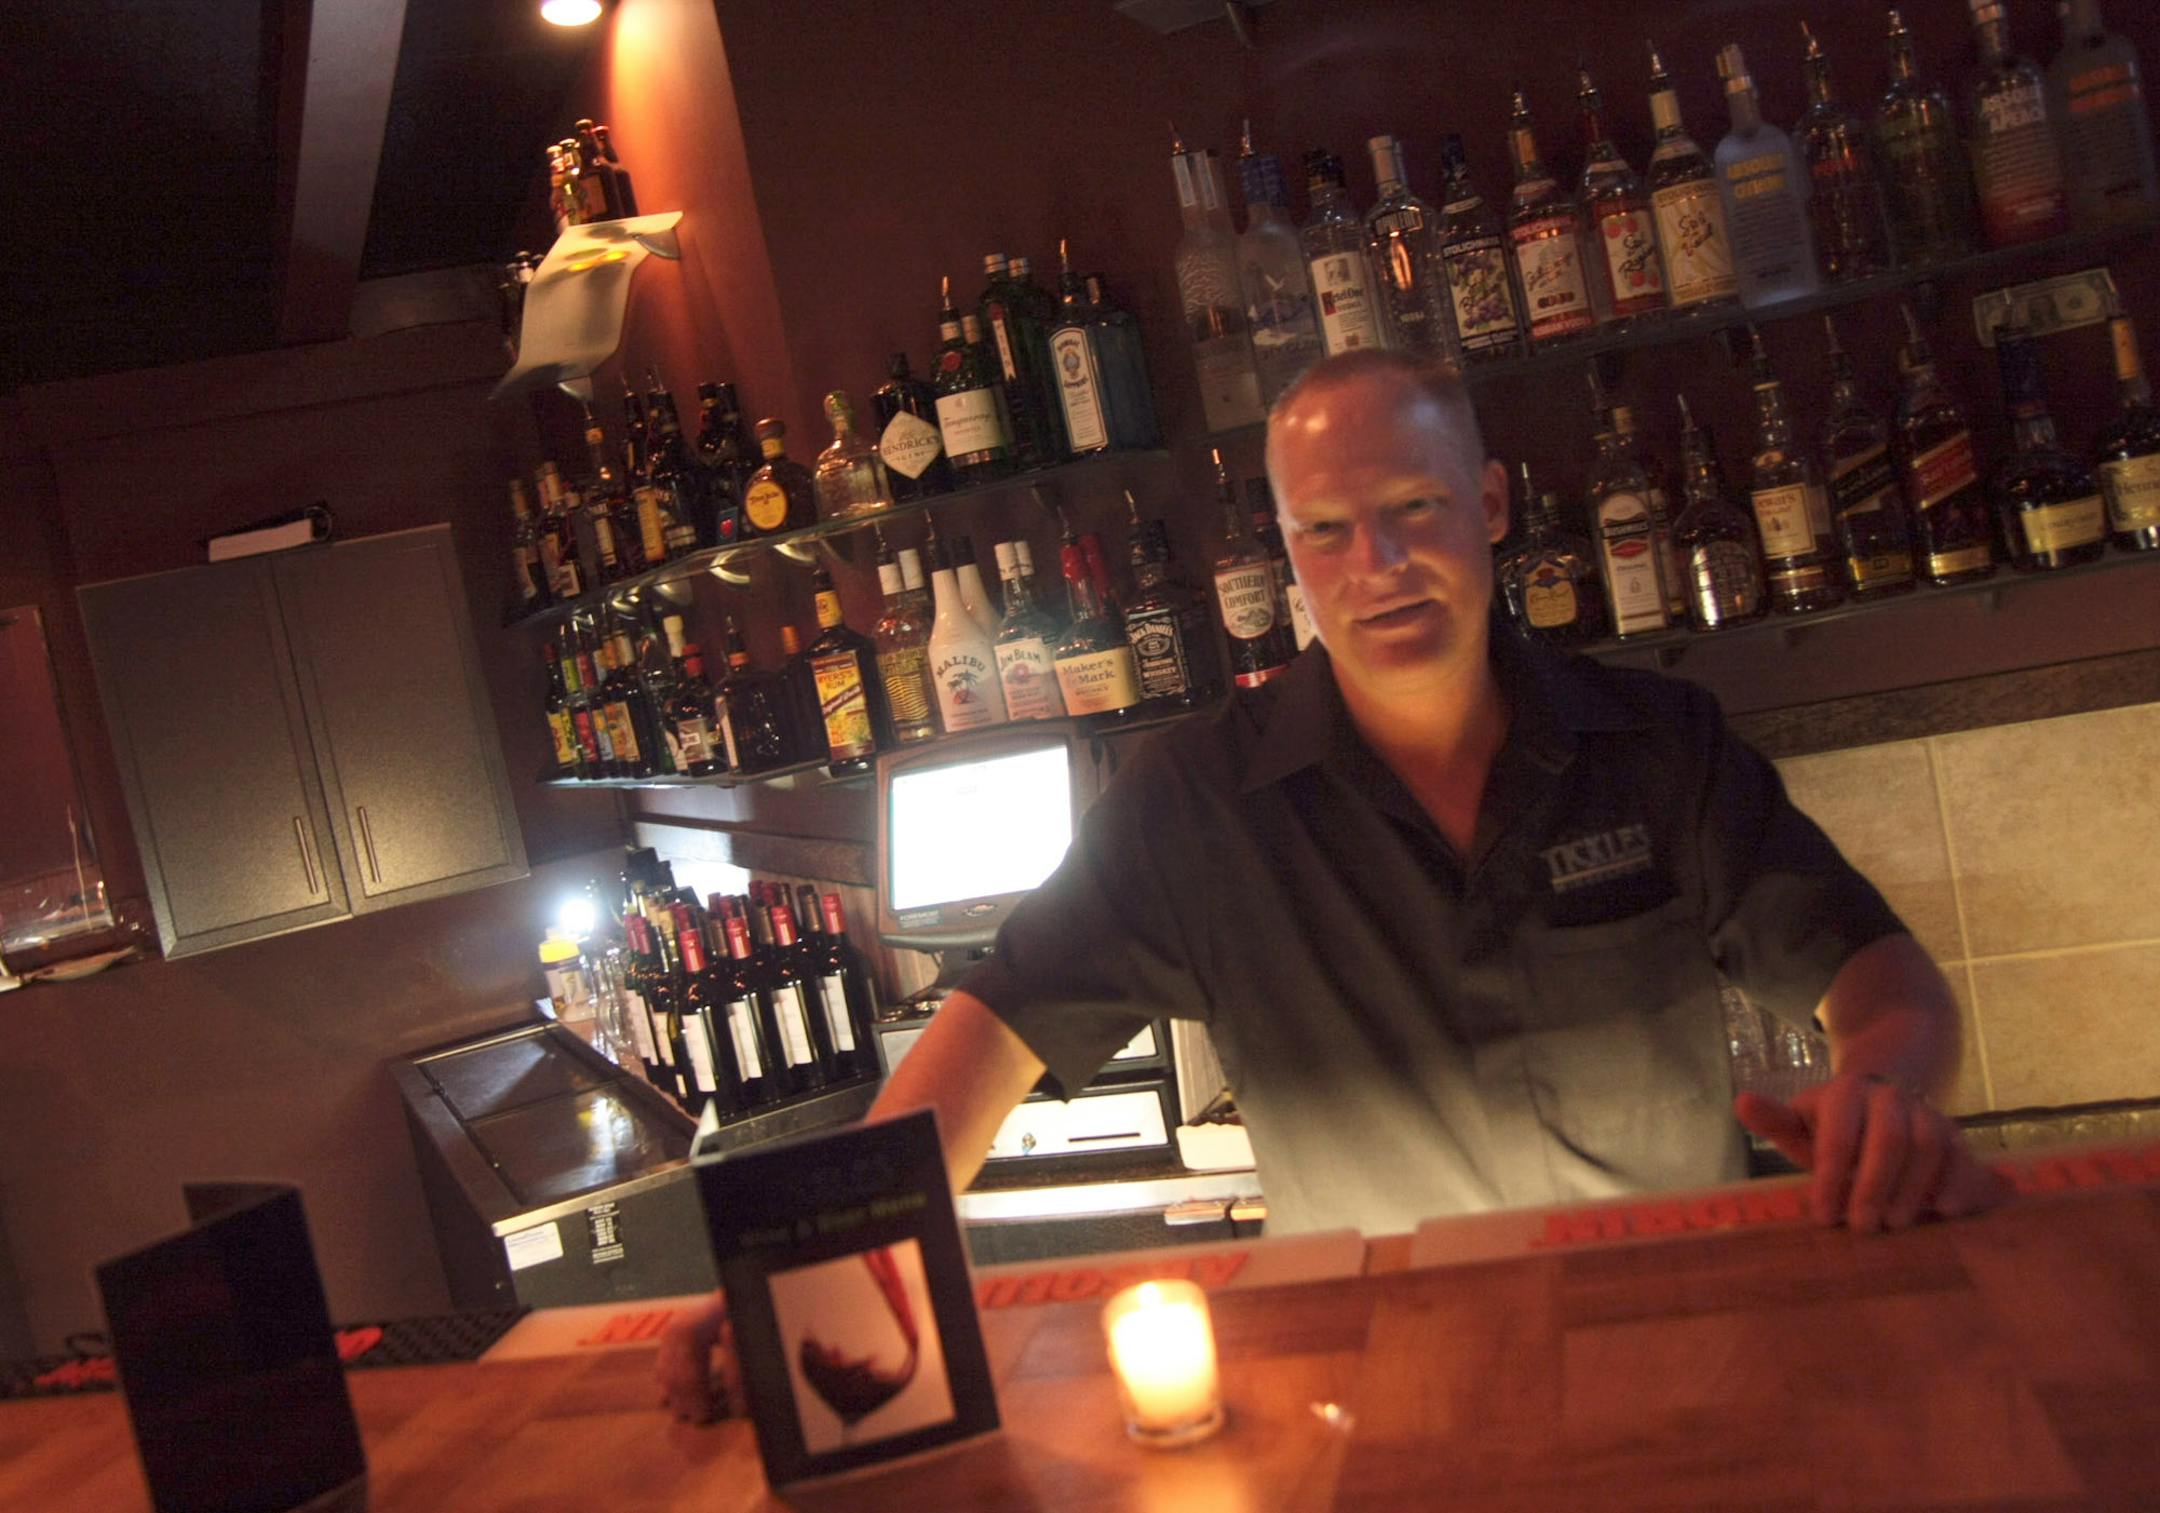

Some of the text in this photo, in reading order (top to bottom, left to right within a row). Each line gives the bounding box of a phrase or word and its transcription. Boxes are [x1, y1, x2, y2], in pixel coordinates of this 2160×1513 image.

[1219, 574, 1264, 593] SOUTHERN
[1224, 589, 1264, 608] COMFORT
[937, 655, 986, 677] MALIBU
[1063, 660, 1114, 674] Maker's
[1079, 670, 1116, 684] Mark
